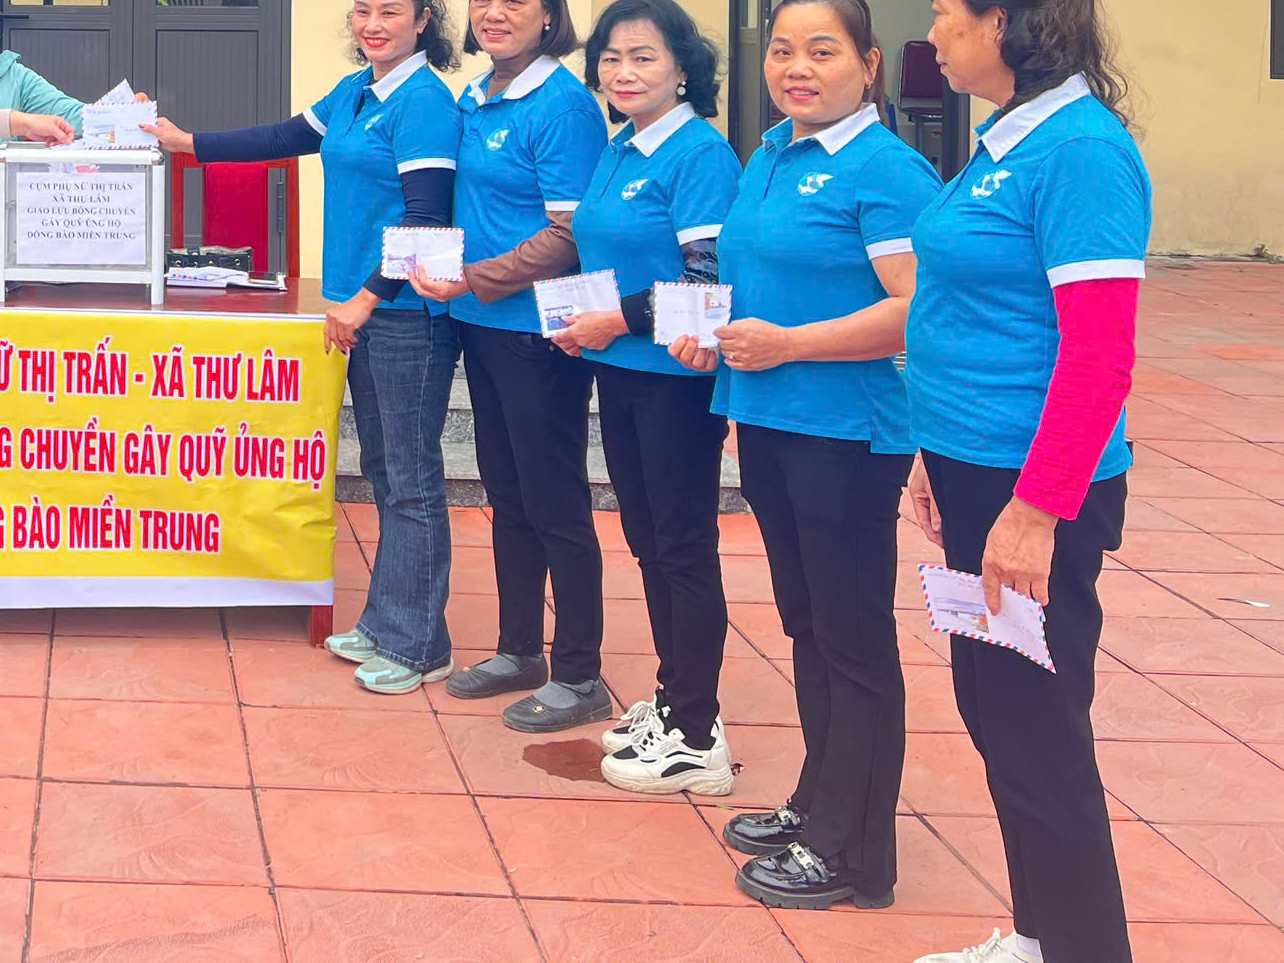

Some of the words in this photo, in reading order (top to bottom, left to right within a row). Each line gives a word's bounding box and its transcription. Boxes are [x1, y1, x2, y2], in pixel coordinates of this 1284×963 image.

[27, 207, 49, 215] GIAO
[104, 231, 136, 239] TRUNG
[18, 350, 55, 403] THỊ
[63, 336, 126, 395] TRẤN
[152, 347, 184, 397] XÃ
[193, 353, 242, 400] THƯ
[247, 349, 300, 401] LÂM
[20, 417, 115, 472] CHUYỀN
[123, 424, 171, 475] GÂY
[179, 427, 227, 482] QUỸ
[234, 422, 285, 478] ỦNG
[293, 430, 325, 489] HỘ
[12, 496, 60, 549] BÀO
[69, 494, 131, 549] MIỀN
[139, 509, 220, 553] TRUNG
